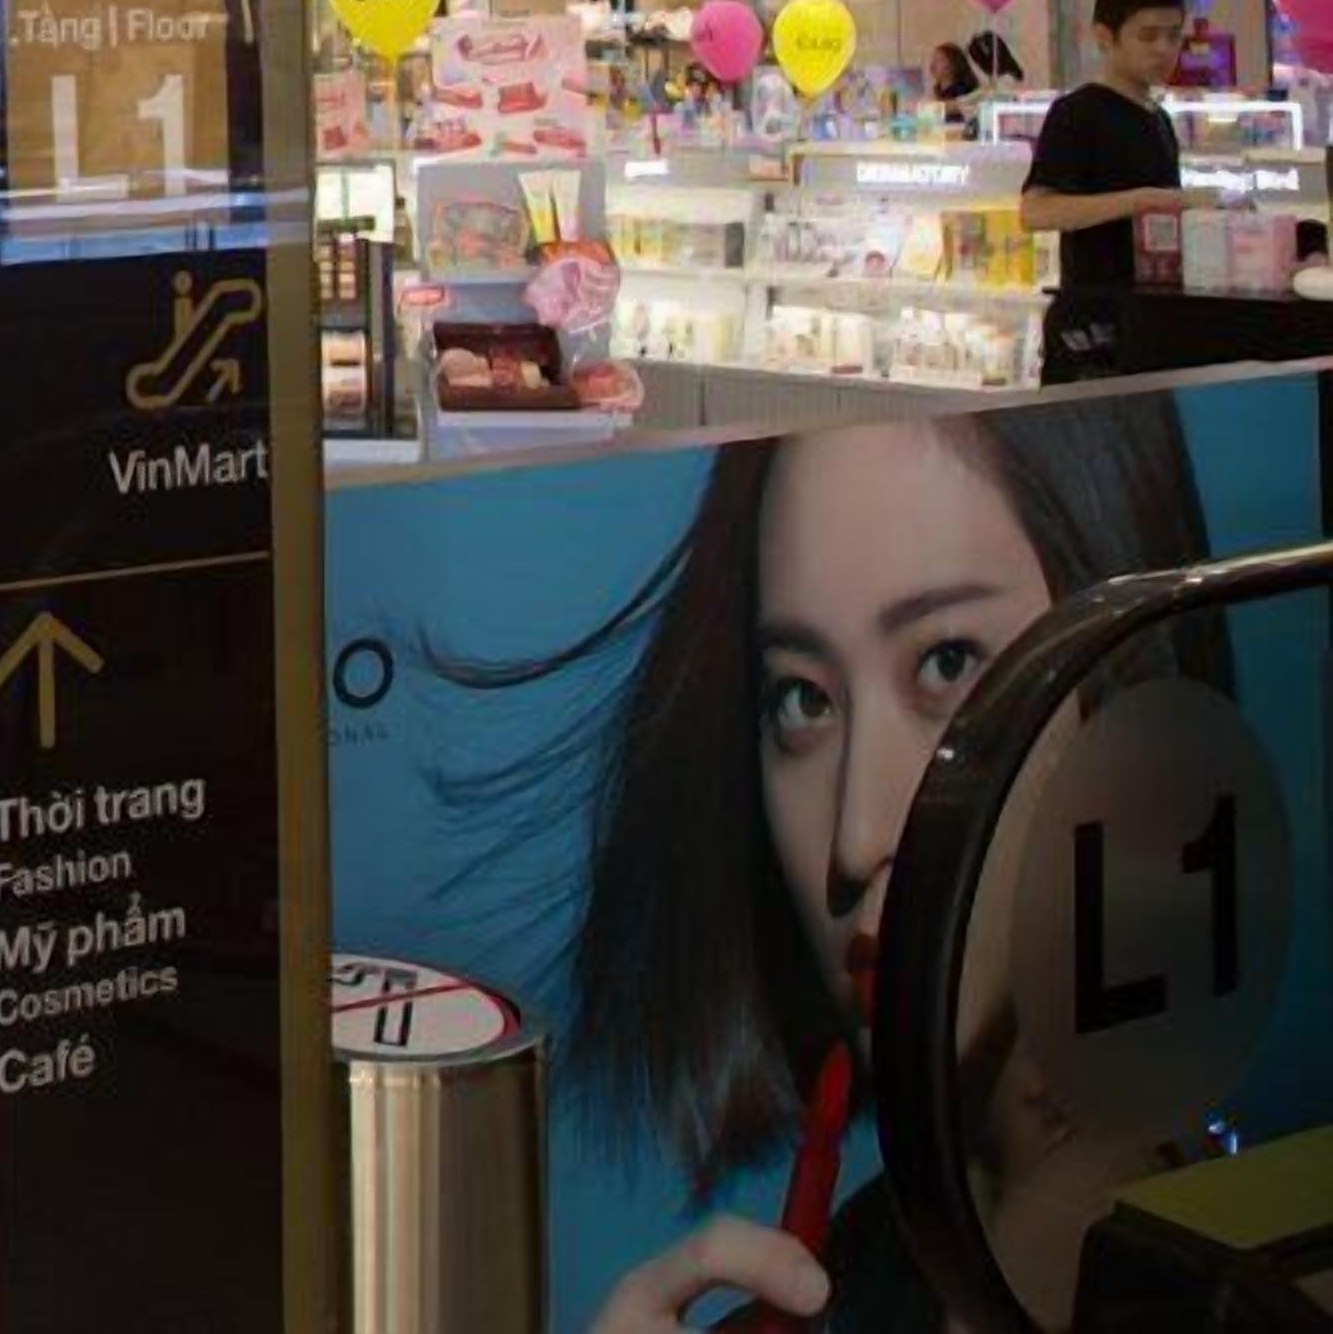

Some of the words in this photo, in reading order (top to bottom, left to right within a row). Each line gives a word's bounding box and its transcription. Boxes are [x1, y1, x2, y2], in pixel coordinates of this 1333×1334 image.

[128, 8, 209, 43] Floor
[51, 74, 186, 203] L1
[108, 441, 269, 496] VinMart
[93, 778, 205, 823] trang
[67, 891, 186, 966] phẩm
